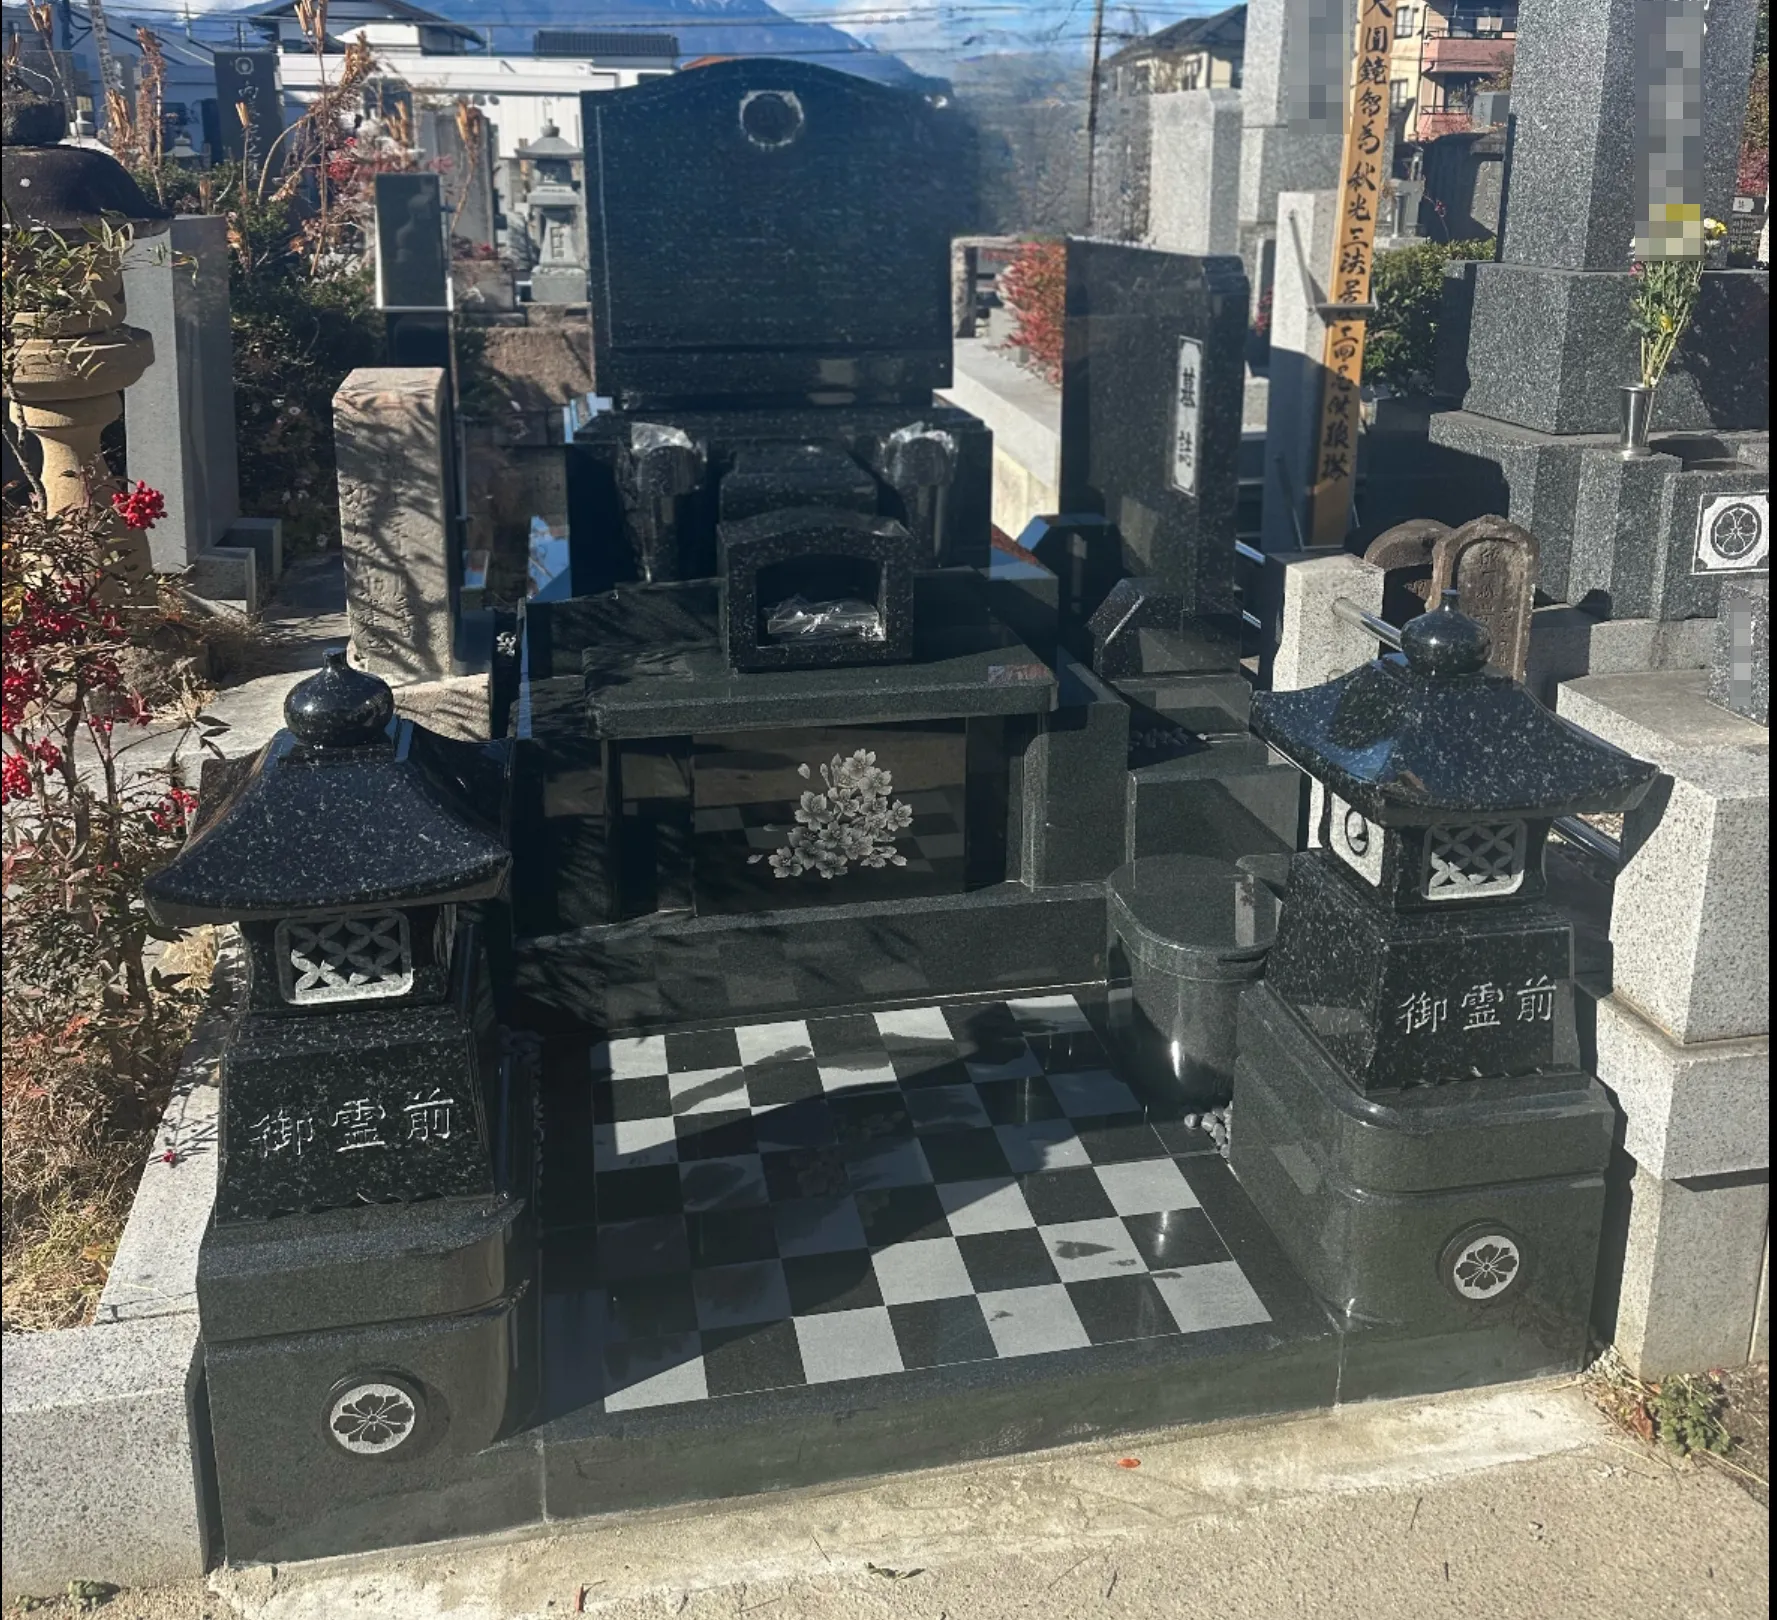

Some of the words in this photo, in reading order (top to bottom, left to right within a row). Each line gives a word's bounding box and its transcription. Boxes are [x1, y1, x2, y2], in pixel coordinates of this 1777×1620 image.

[1397, 974, 1557, 1034] 御霊前
[249, 1087, 454, 1158] 御霊前
